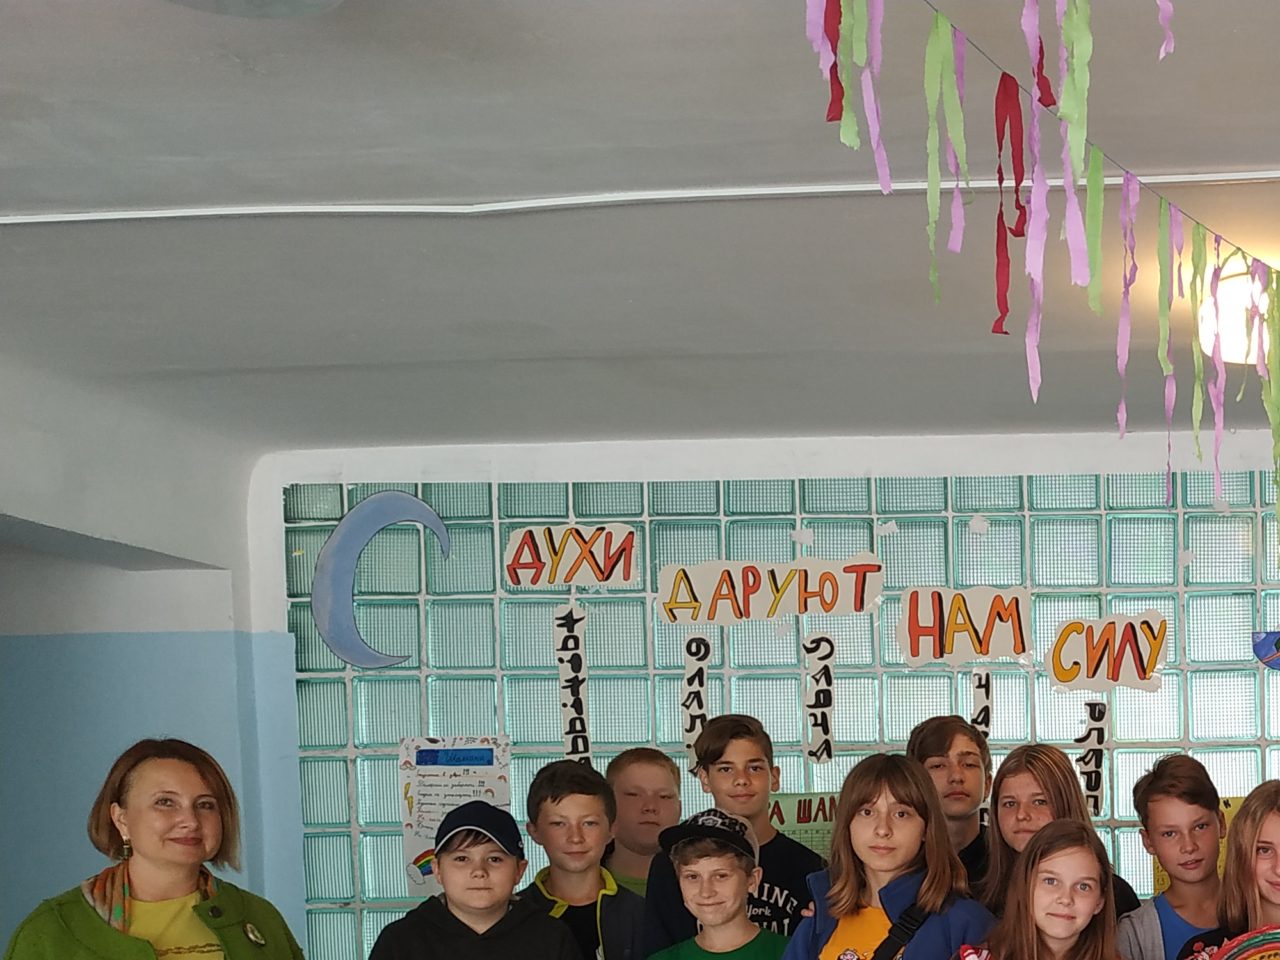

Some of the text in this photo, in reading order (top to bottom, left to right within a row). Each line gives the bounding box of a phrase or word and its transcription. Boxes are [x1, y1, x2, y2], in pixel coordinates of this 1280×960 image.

[506, 527, 1167, 682] ДУХИ ДАРУЮТ НАМ СИЛУ
[797, 795, 838, 824] ШАМ
